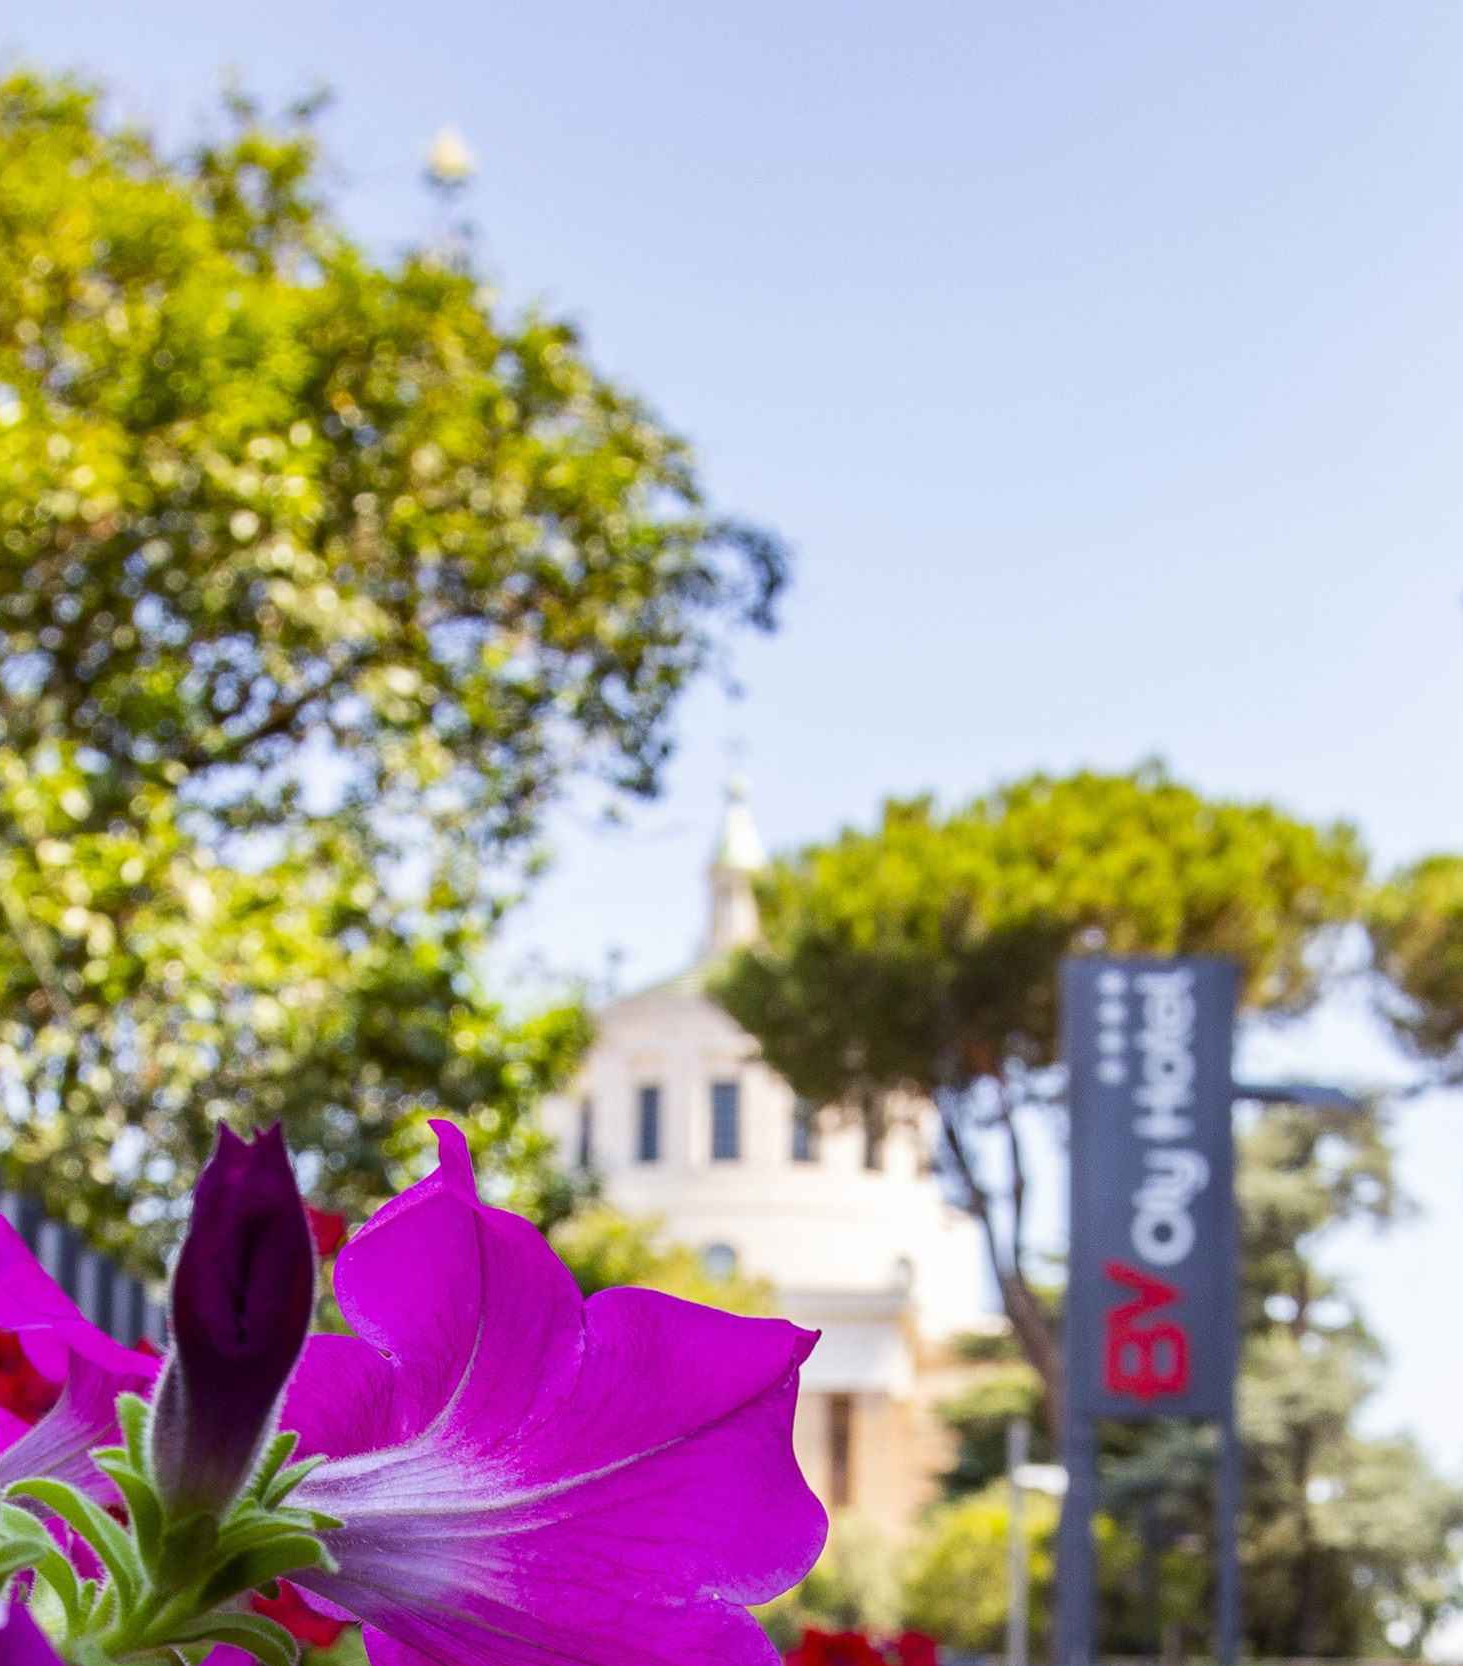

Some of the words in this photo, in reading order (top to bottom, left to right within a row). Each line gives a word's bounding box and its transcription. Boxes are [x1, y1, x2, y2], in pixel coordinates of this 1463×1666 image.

[1133, 965, 1196, 1139] Hotel
[1131, 1148, 1210, 1266] Oly
[1102, 1258, 1190, 1404] BV
